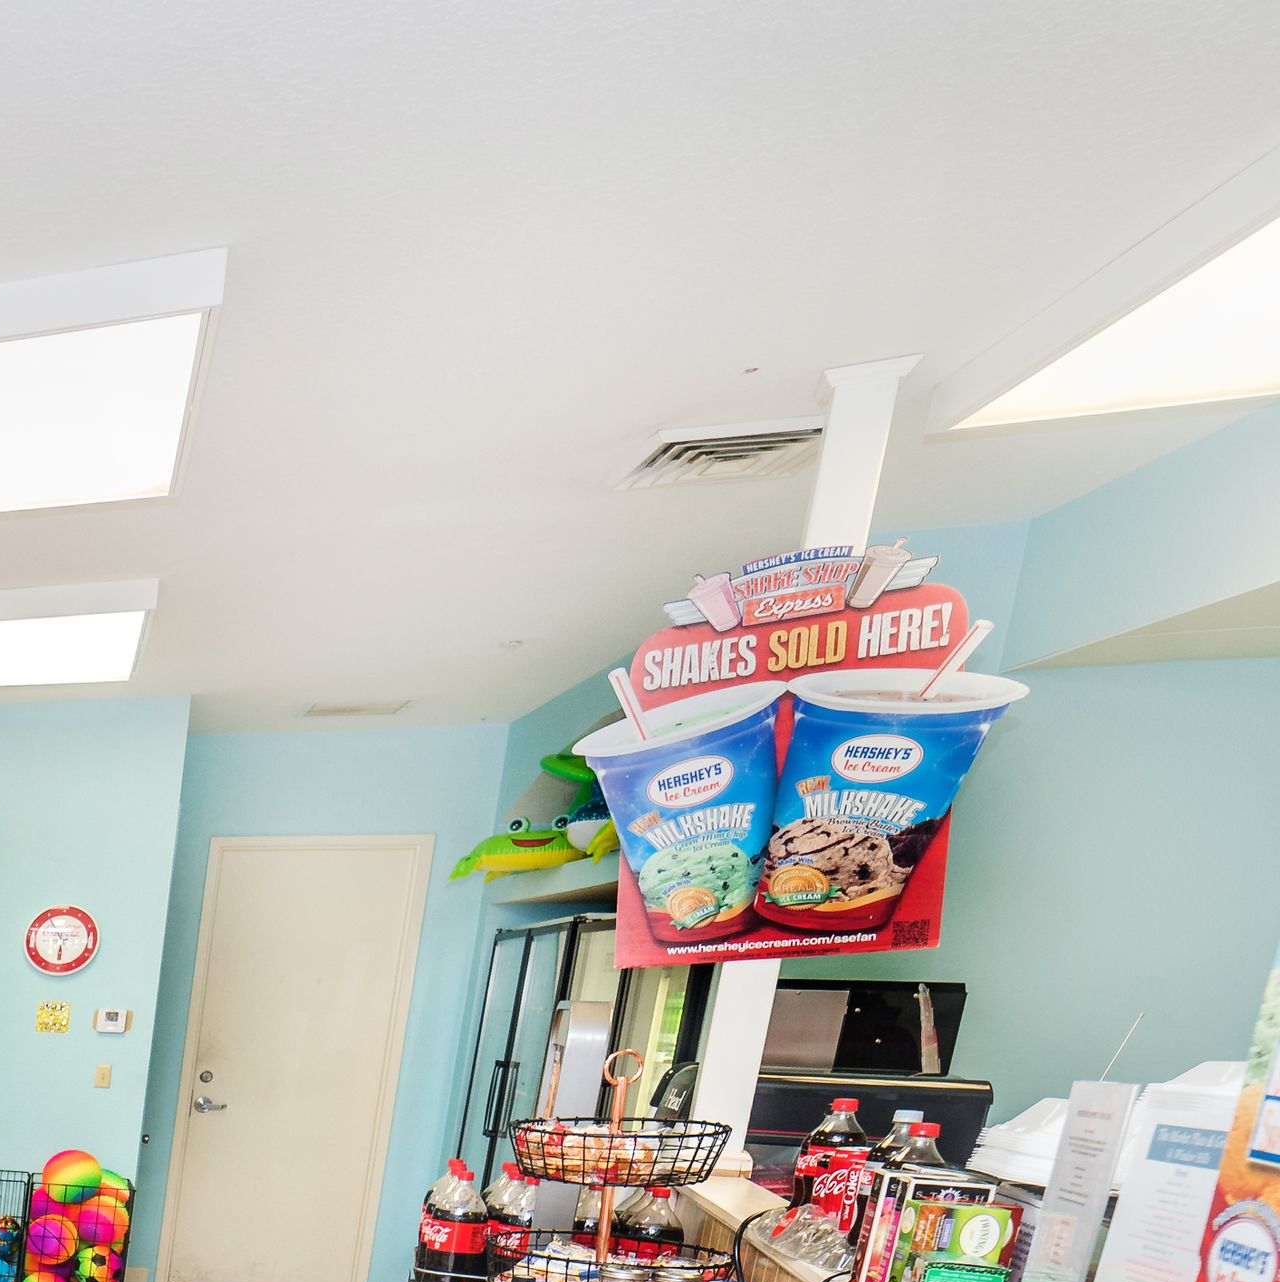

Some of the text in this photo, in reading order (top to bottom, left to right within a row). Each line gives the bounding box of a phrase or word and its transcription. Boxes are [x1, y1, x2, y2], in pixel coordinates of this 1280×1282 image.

[801, 549, 815, 560] ICE
[818, 546, 850, 558] CREAM
[733, 561, 860, 599] SHAKE SHOP
[754, 592, 833, 619] Express
[642, 601, 953, 692] SHAKES SOLD HERE!
[844, 745, 914, 760] HERSHEY'S
[658, 763, 723, 791] HERSHEY'S
[843, 760, 901, 773] Ice Cream
[664, 780, 721, 802] Ice Cream
[797, 776, 831, 796] REAL
[804, 790, 927, 827] MILKSHAKE
[645, 803, 756, 851] MILKSHAKE
[844, 1170, 861, 1207] Coke
